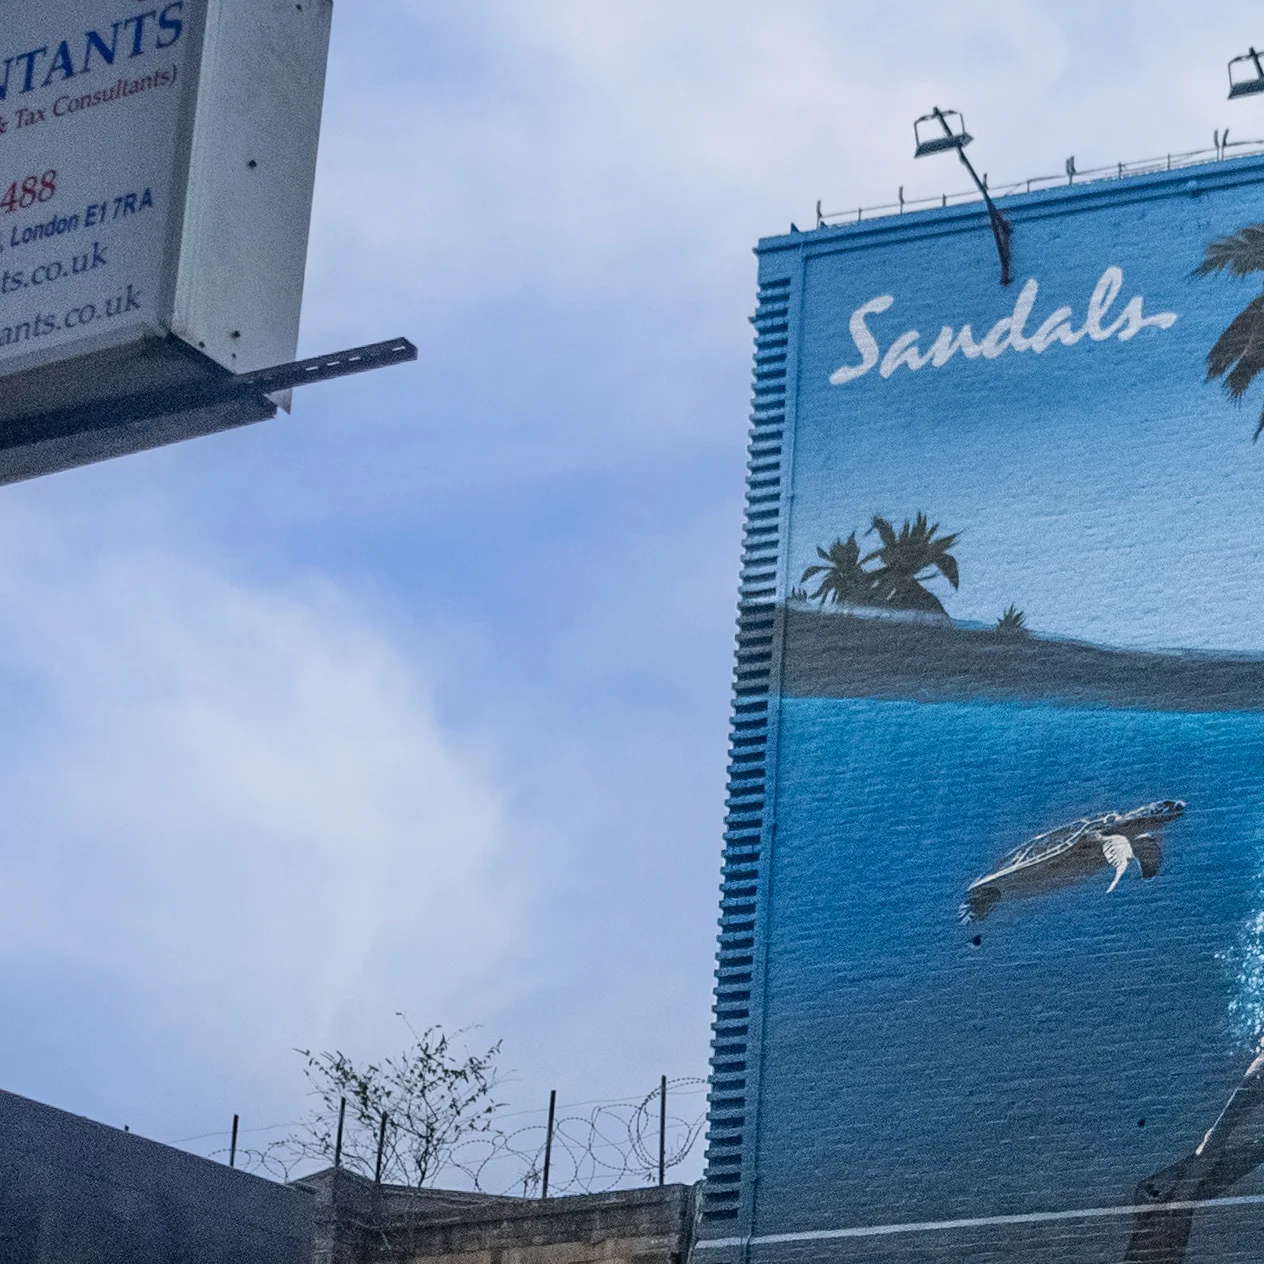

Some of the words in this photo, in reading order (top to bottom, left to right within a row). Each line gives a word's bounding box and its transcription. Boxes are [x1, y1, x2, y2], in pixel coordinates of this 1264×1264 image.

[15, 107, 46, 129] Tax
[51, 63, 178, 118] Consultants)
[0, 169, 57, 214] 488
[10, 214, 80, 247] London
[84, 202, 108, 228] E1
[113, 186, 154, 220] 7RA
[0, 241, 109, 293] ts.co.uk
[0, 284, 143, 346] ants.co.uk
[829, 265, 1177, 385] Sandals
